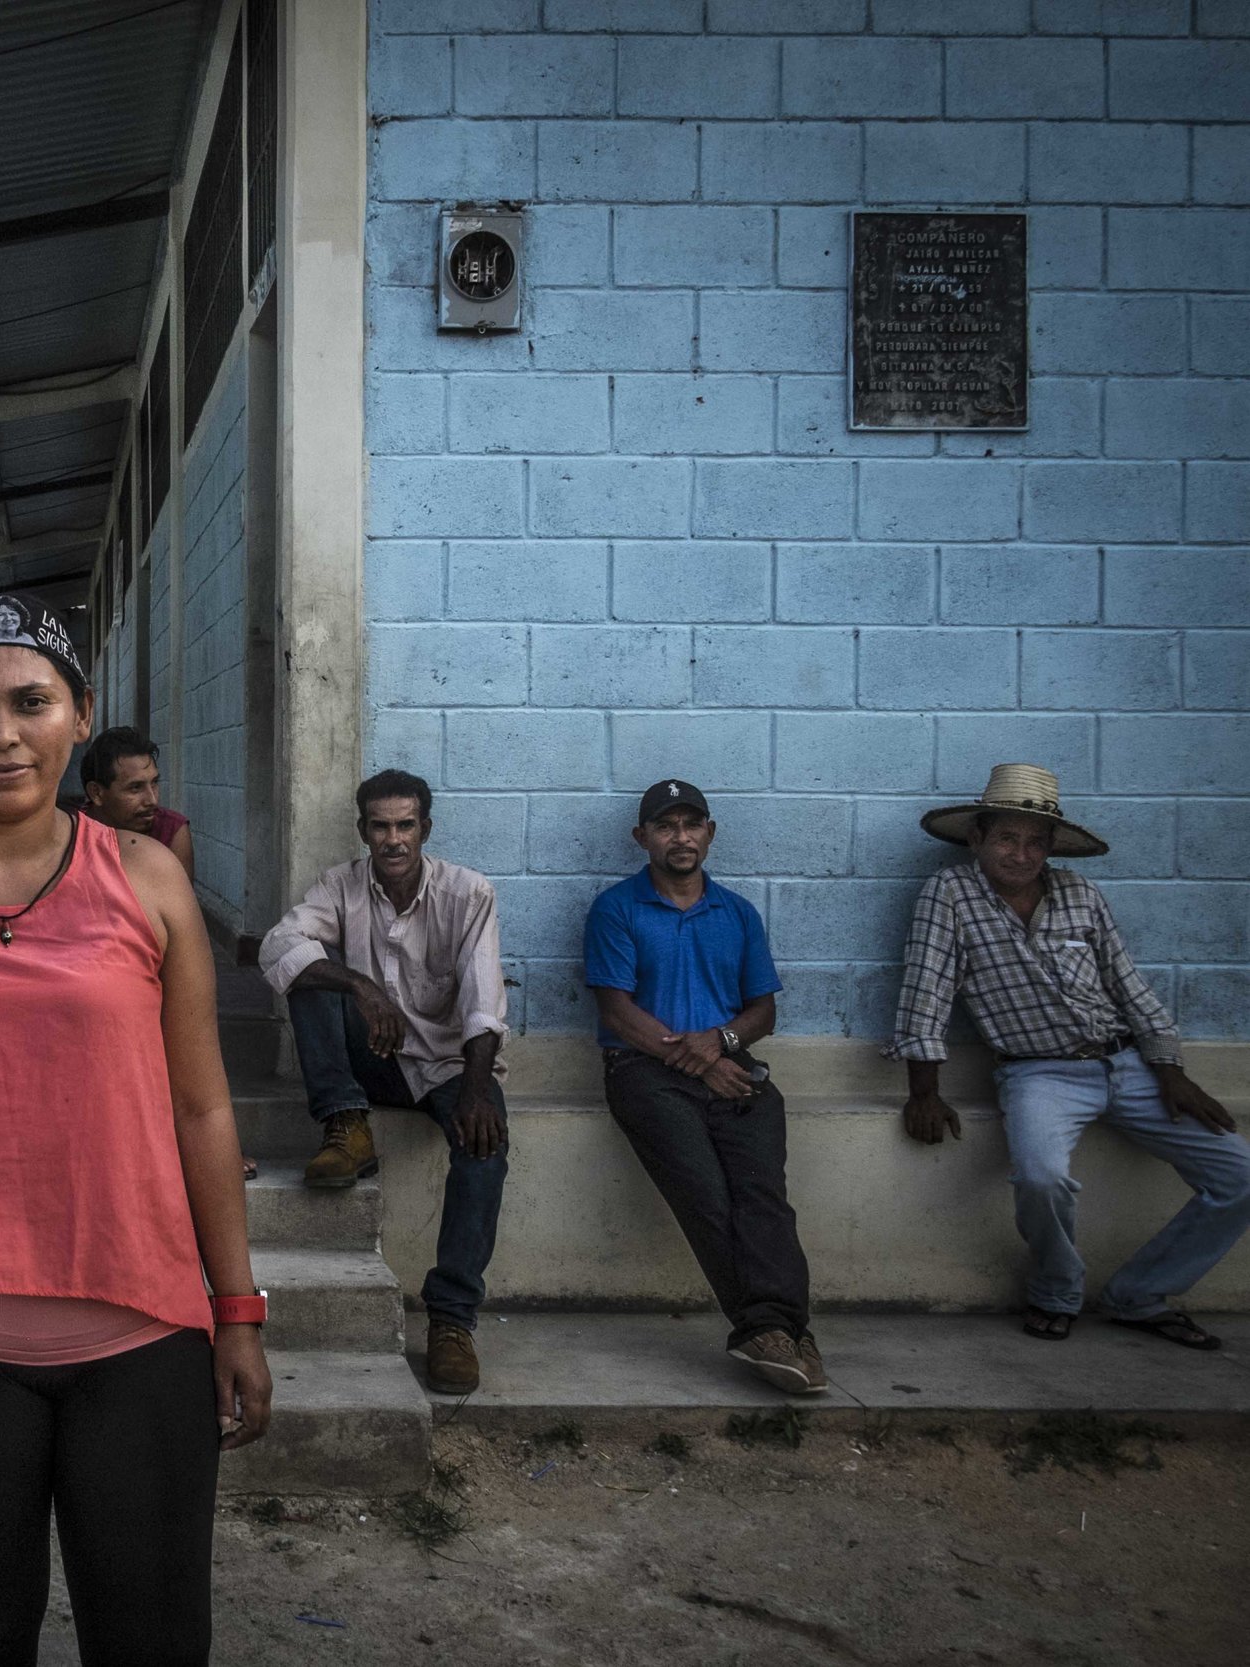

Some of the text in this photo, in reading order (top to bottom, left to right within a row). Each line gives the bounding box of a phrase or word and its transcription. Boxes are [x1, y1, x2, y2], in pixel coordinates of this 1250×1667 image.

[905, 248, 940, 259] JAIRO
[908, 264, 945, 274] AYALA
[879, 322, 1001, 333] PORQUE TU EJEMPLO
[876, 341, 989, 352] PERDURARA SIEMPRE
[857, 381, 864, 391] Y
[900, 381, 948, 392] POPULAR
[931, 401, 960, 411] 2007
[42, 609, 58, 632] LA
